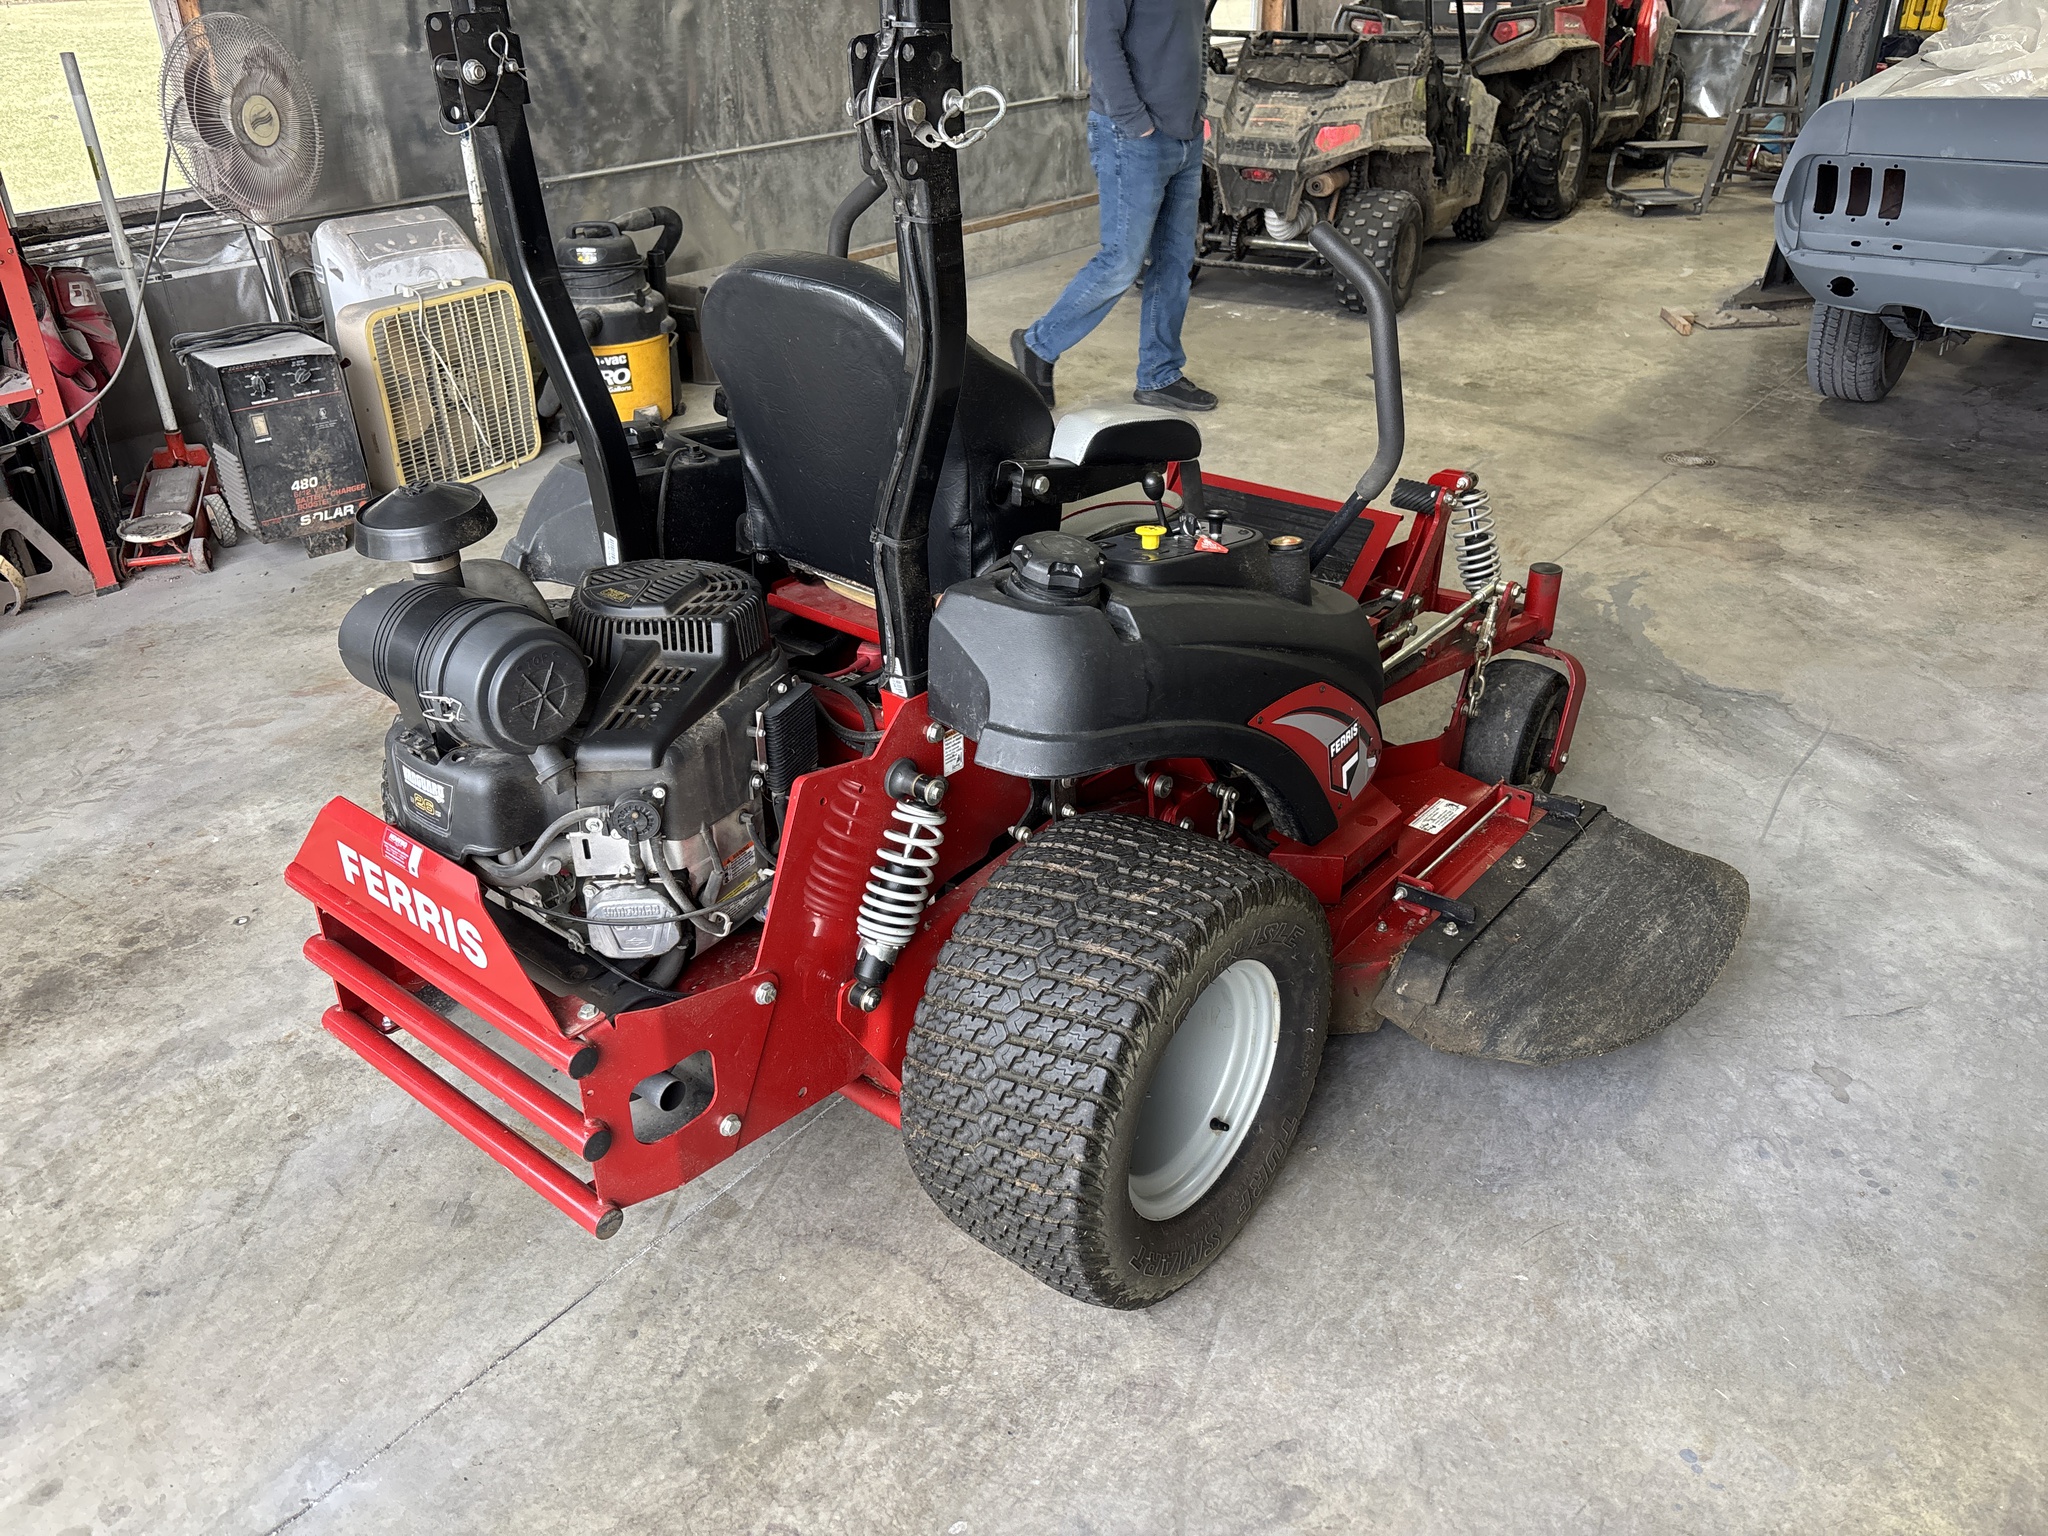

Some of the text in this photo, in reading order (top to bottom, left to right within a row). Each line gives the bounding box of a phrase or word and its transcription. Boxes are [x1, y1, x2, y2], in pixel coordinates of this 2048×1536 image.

[291, 476, 318, 491] 480
[330, 483, 366, 497] CHARGER
[300, 504, 355, 526] SOLAR
[1330, 722, 1358, 758] FERRIS
[337, 840, 488, 969] FERRIS
